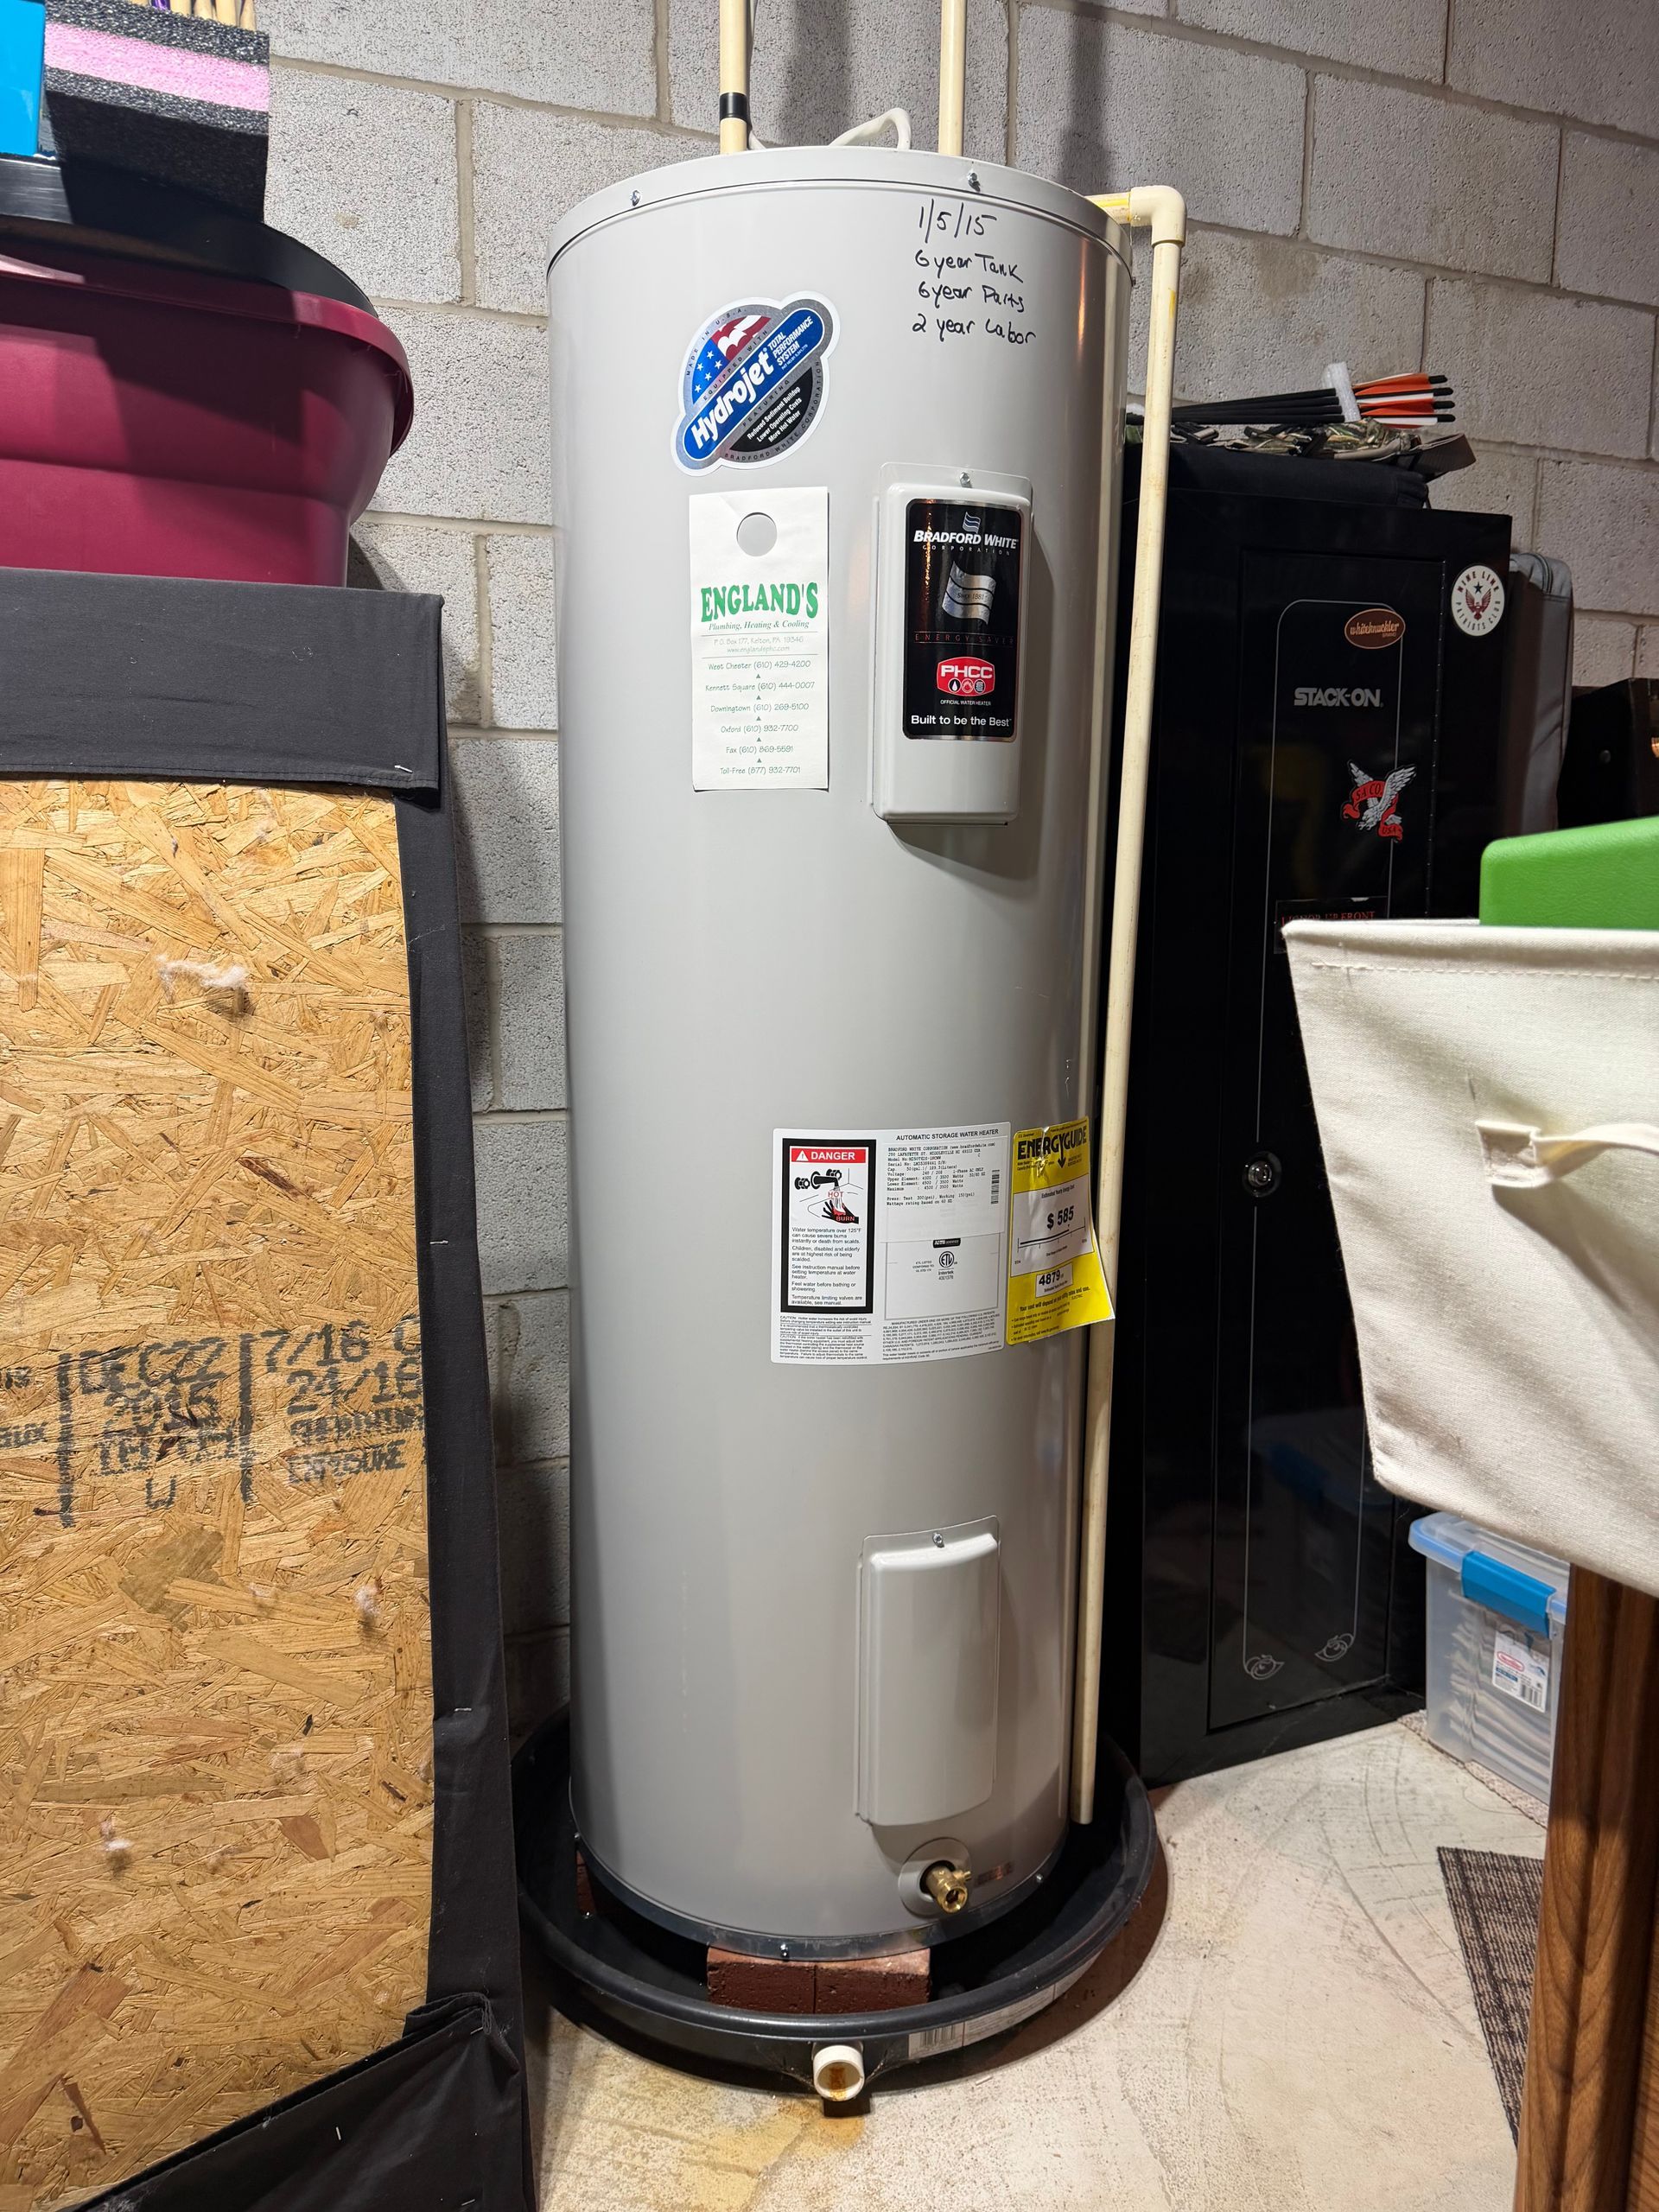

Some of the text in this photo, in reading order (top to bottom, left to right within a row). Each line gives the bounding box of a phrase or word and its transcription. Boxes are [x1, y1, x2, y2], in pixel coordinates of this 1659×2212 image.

[918, 199, 997, 243] 1/5/15
[934, 256, 972, 278] year
[975, 253, 1023, 283] Tank
[932, 284, 972, 308] year
[982, 285, 1025, 312] Parts
[768, 332, 786, 350] TOTAL
[772, 316, 814, 358] PERFORMANCE
[912, 313, 1036, 344] 2 year Labor
[703, 330, 768, 401] EQUIPPED WITH
[776, 341, 800, 366] SYSTEM
[725, 362, 822, 461] BRADFORD WHITE CORPORATION
[743, 379, 789, 427] FEATURING
[747, 387, 800, 440] Reduced Sediment Buildup
[757, 397, 802, 442] Lower Operating Costs
[768, 410, 800, 442] More Hot Water
[913, 530, 1017, 549] BRADFORD WHITE
[922, 545, 1010, 556] CORPORATION
[701, 582, 818, 622] ENGLAND'S
[754, 661, 772, 670] (610)
[941, 665, 992, 678] PHCC
[758, 682, 776, 691] (610)
[1294, 688, 1381, 708] STACK-ON
[912, 715, 1009, 726] Built to be the Best
[810, 1152, 855, 1160] DANGER
[1018, 1125, 1086, 1160] ENERGYGUIDE
[1058, 1205, 1074, 1225] 585
[1039, 1270, 1060, 1286] 4879
